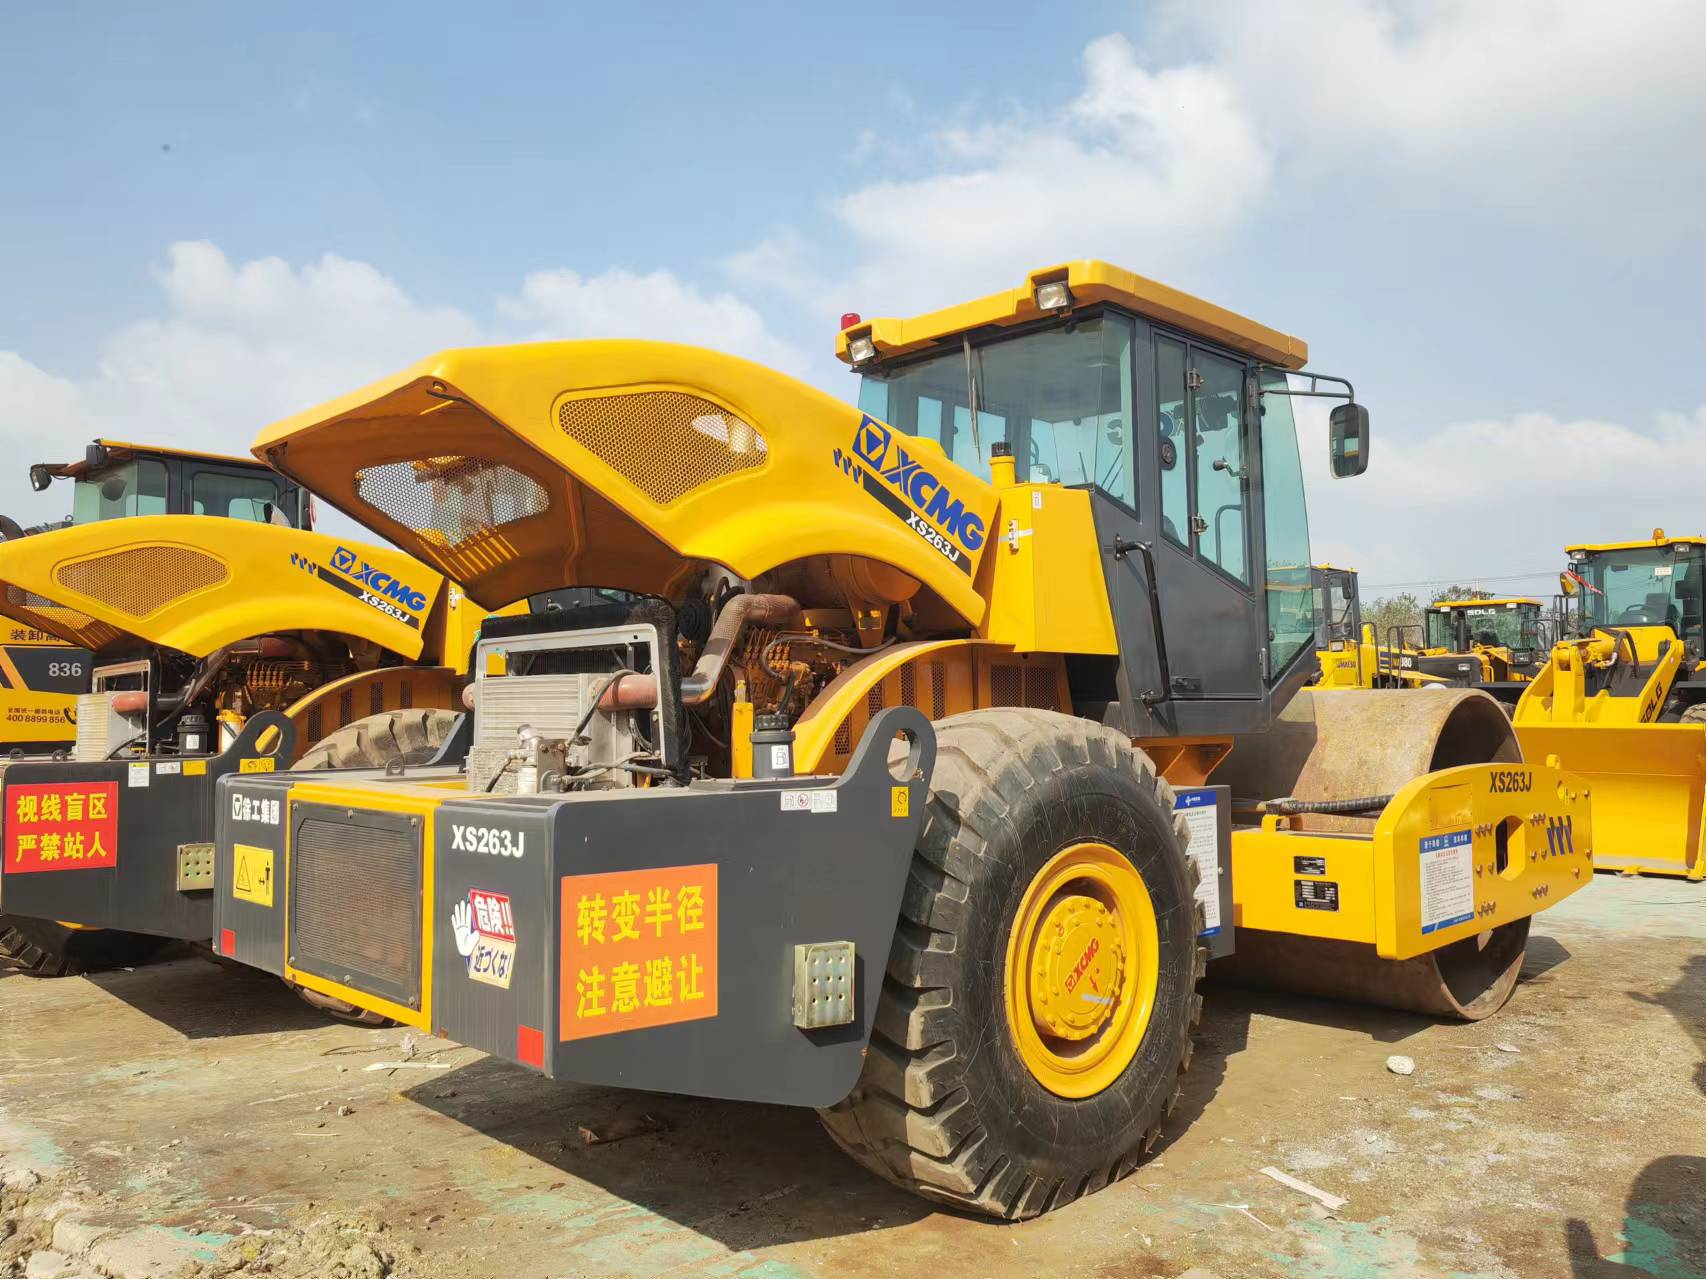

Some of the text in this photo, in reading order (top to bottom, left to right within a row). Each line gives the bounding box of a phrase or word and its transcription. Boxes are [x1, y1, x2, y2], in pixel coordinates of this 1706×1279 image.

[879, 444, 985, 551] XCMG
[905, 510, 960, 562] XS263J
[349, 560, 427, 611] XCMG
[358, 590, 410, 623] XS263J
[1467, 608, 1496, 616] SDLG
[48, 662, 82, 677] 836
[7, 714, 23, 722] 400
[49, 716, 66, 724] 856
[1489, 771, 1532, 793] XS263J
[16, 792, 108, 824] 视线盲区
[242, 797, 280, 825] 徐工集团
[15, 831, 108, 862] 严禁站人
[451, 824, 525, 858] XS263J
[576, 885, 705, 946] 转变半径
[1073, 938, 1099, 982] XCMG
[576, 953, 705, 1020] 注意避让
